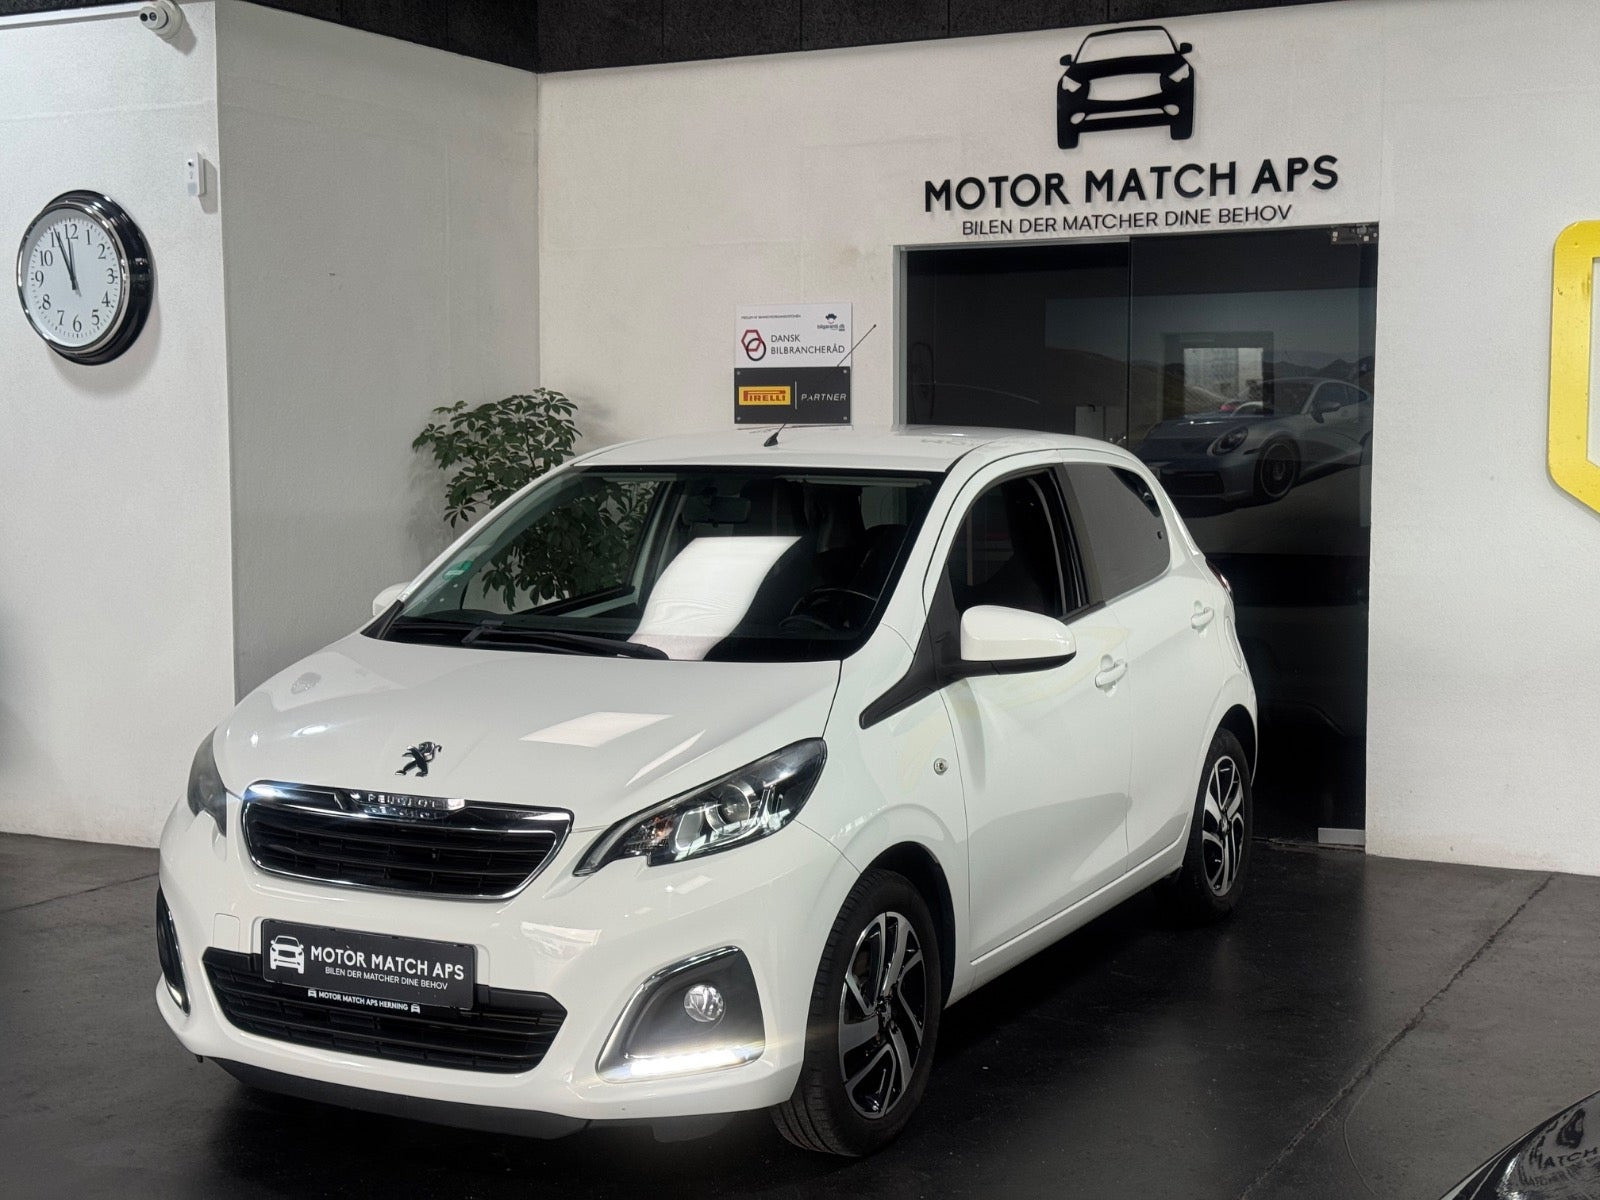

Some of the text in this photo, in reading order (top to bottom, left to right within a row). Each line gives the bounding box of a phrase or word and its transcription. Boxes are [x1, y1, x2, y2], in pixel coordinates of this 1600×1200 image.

[924, 154, 1339, 212] MOTOR MATCH APS
[962, 204, 1292, 236] BILEN DER MATCHER DINE BEHOV
[65, 223, 79, 240] 12
[86, 229, 92, 245] 1
[39, 251, 54, 268] 10
[97, 243, 106, 260] 2
[35, 270, 44, 287] 9
[106, 268, 115, 284] 3
[42, 294, 51, 310] 8
[101, 291, 110, 307] 4
[57, 310, 65, 326] 7
[72, 314, 82, 332] 6
[92, 309, 100, 326] 5
[770, 334, 800, 343] DANSK
[770, 343, 845, 355] BILBRANCHERÅD
[743, 389, 786, 402] PIRELLI
[801, 393, 847, 401] PARTNER
[310, 945, 464, 981] MOTOR MATCH APS
[325, 967, 448, 990] BILEN DER MATCHER DINE BEHOV
[318, 991, 409, 1011] MOTOR MATCH APS HERNING
